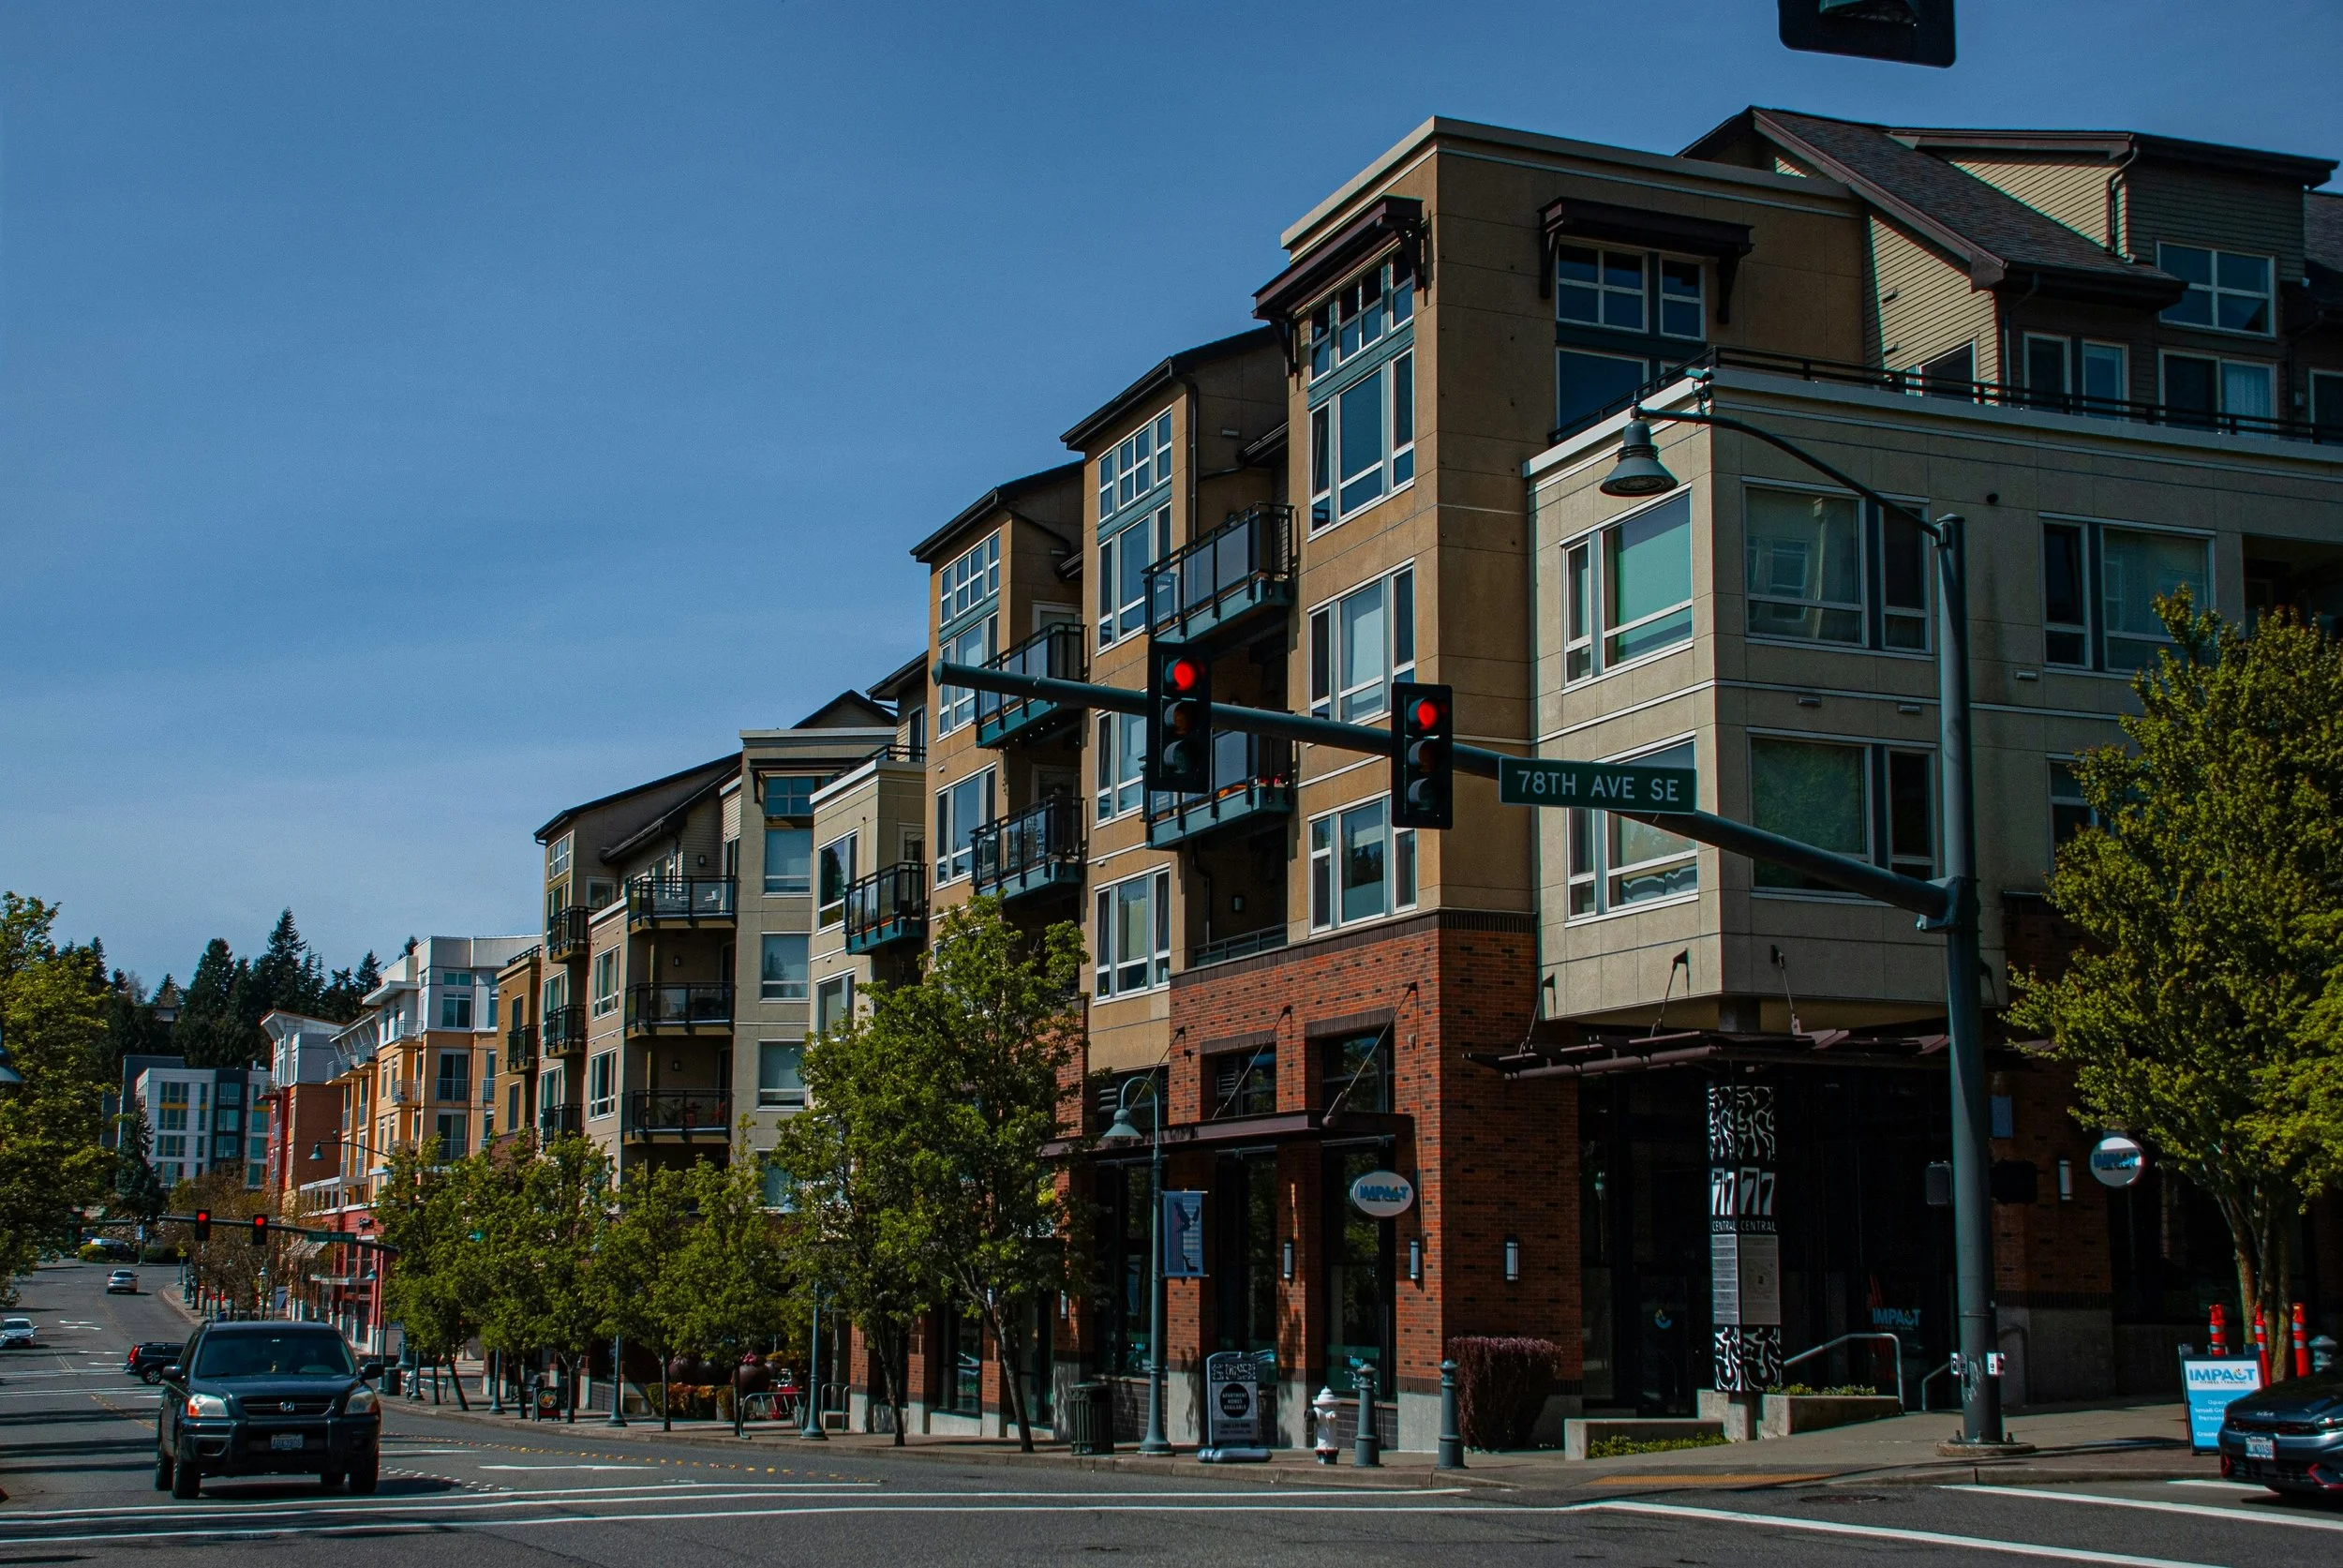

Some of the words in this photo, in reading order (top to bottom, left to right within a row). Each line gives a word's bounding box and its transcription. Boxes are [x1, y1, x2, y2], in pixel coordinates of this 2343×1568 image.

[1516, 770, 1576, 796] 78TH
[1589, 775, 1635, 799] AVE
[1649, 777, 1679, 802] SE
[1739, 1166, 1775, 1216] 77
[1711, 1220, 1737, 1232] CENTRAL
[1739, 1219, 1777, 1232] CENTRAL
[1872, 1307, 1921, 1326] IMPACT
[2188, 1368, 2255, 1381] IMPACT
